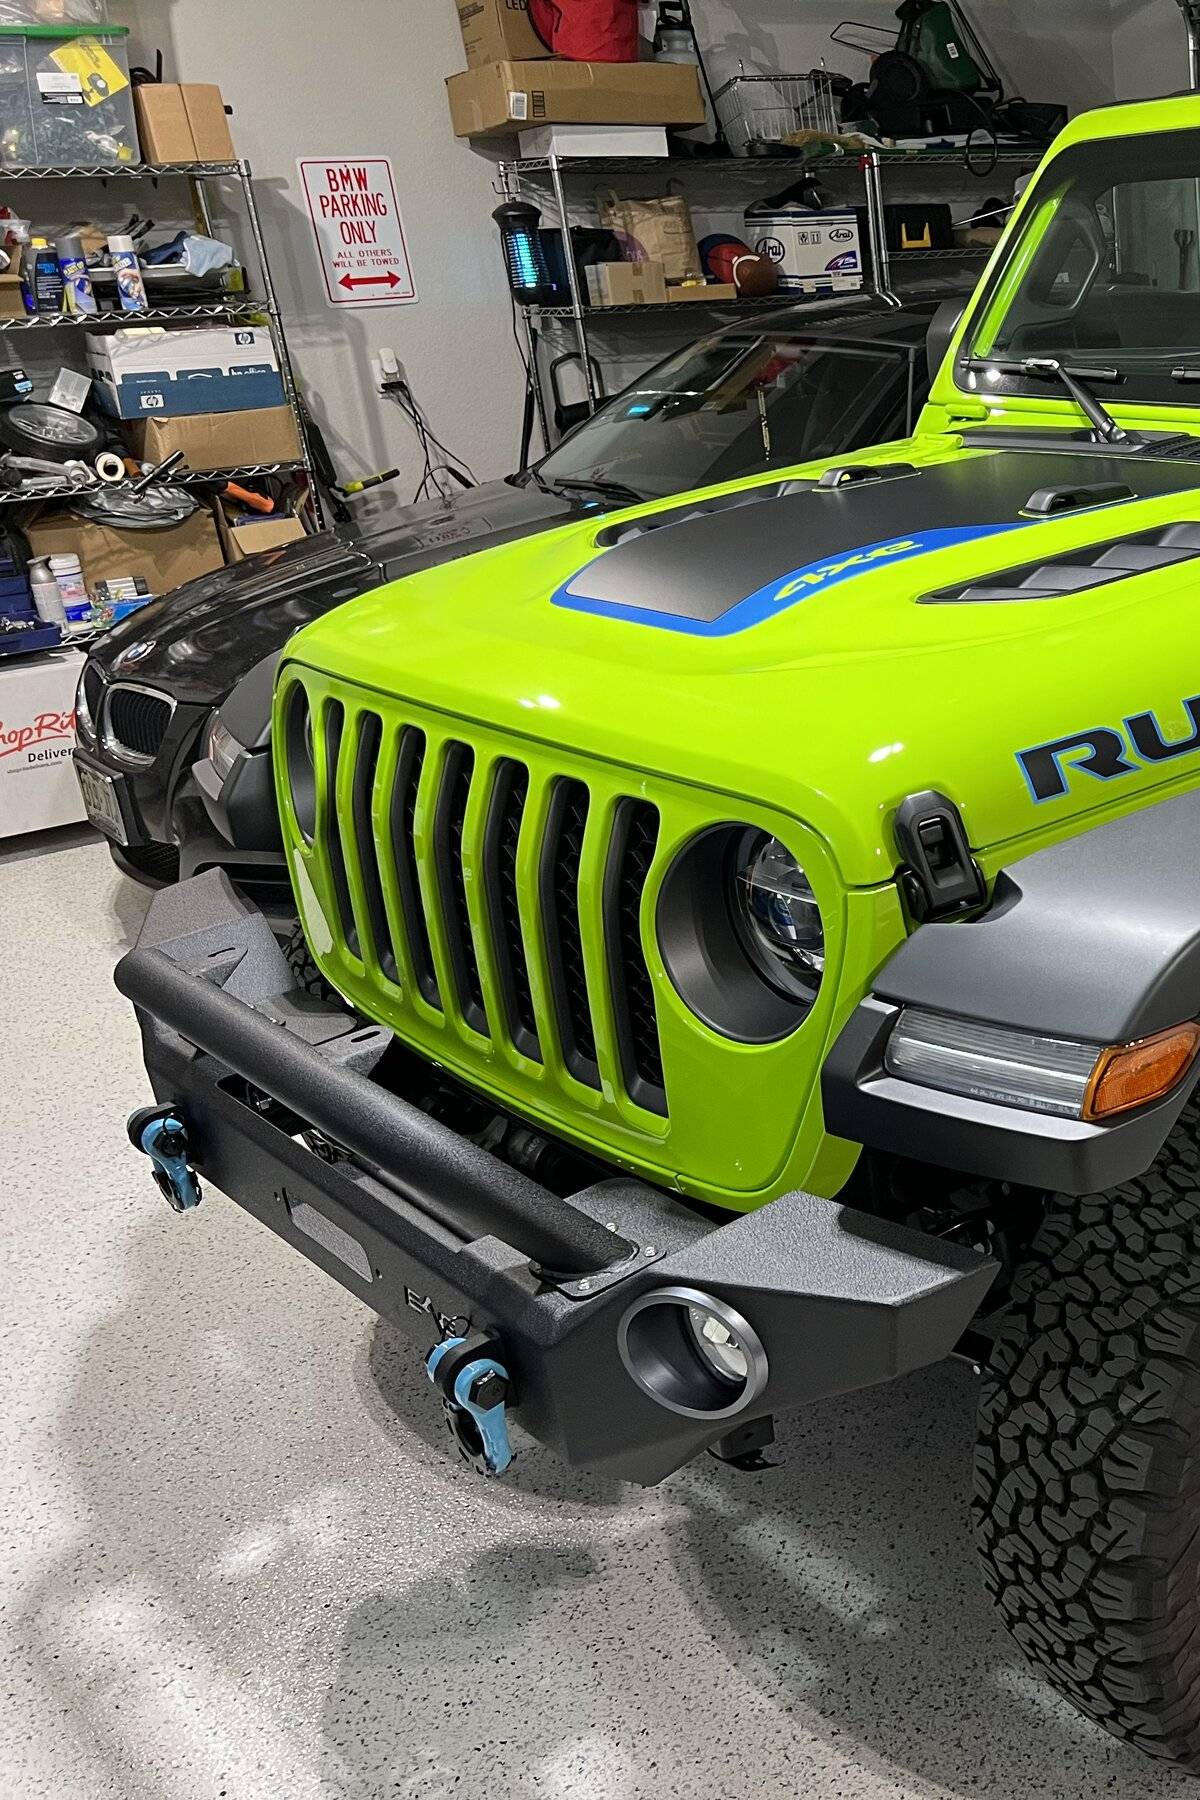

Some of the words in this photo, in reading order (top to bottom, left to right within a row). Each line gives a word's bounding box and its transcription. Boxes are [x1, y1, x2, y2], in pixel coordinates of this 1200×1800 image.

[326, 167, 368, 192] BMW
[319, 193, 387, 218] PARKING
[340, 220, 377, 245] ONLY
[332, 259, 354, 268] WILL
[357, 259, 368, 267] BE
[372, 257, 400, 266] TOWED
[337, 251, 353, 259] ALL
[358, 249, 393, 258] OTHERS
[773, 540, 924, 602] 4xe
[28, 747, 74, 762] Deliver
